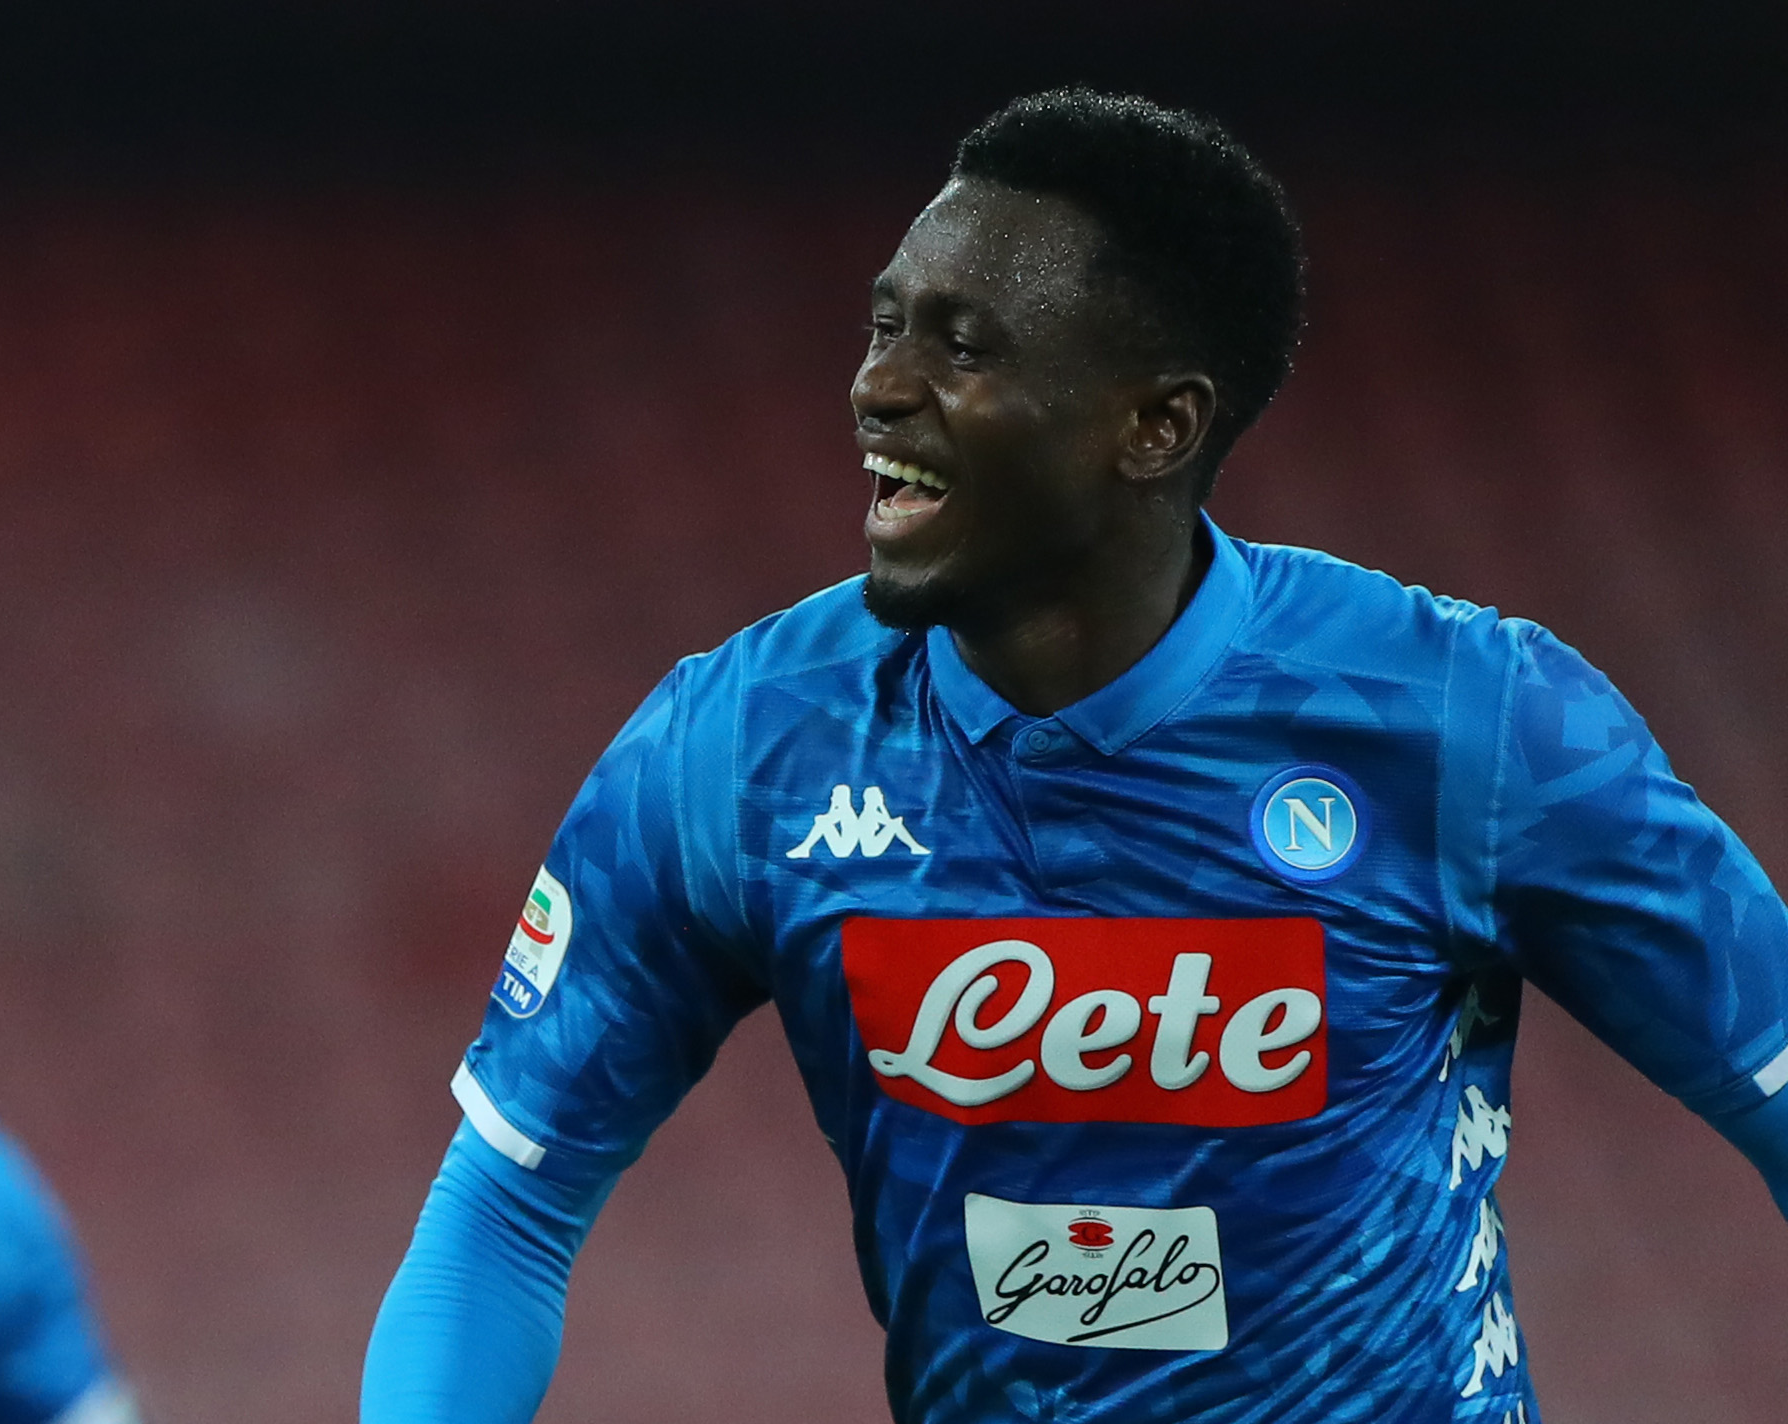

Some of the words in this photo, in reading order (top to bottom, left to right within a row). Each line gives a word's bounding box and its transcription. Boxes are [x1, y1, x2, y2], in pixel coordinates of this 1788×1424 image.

[1282, 796, 1336, 852] N
[502, 970, 533, 1010] TIM
[867, 939, 1324, 1107] Lete
[985, 1228, 1220, 1342] Garofalo
